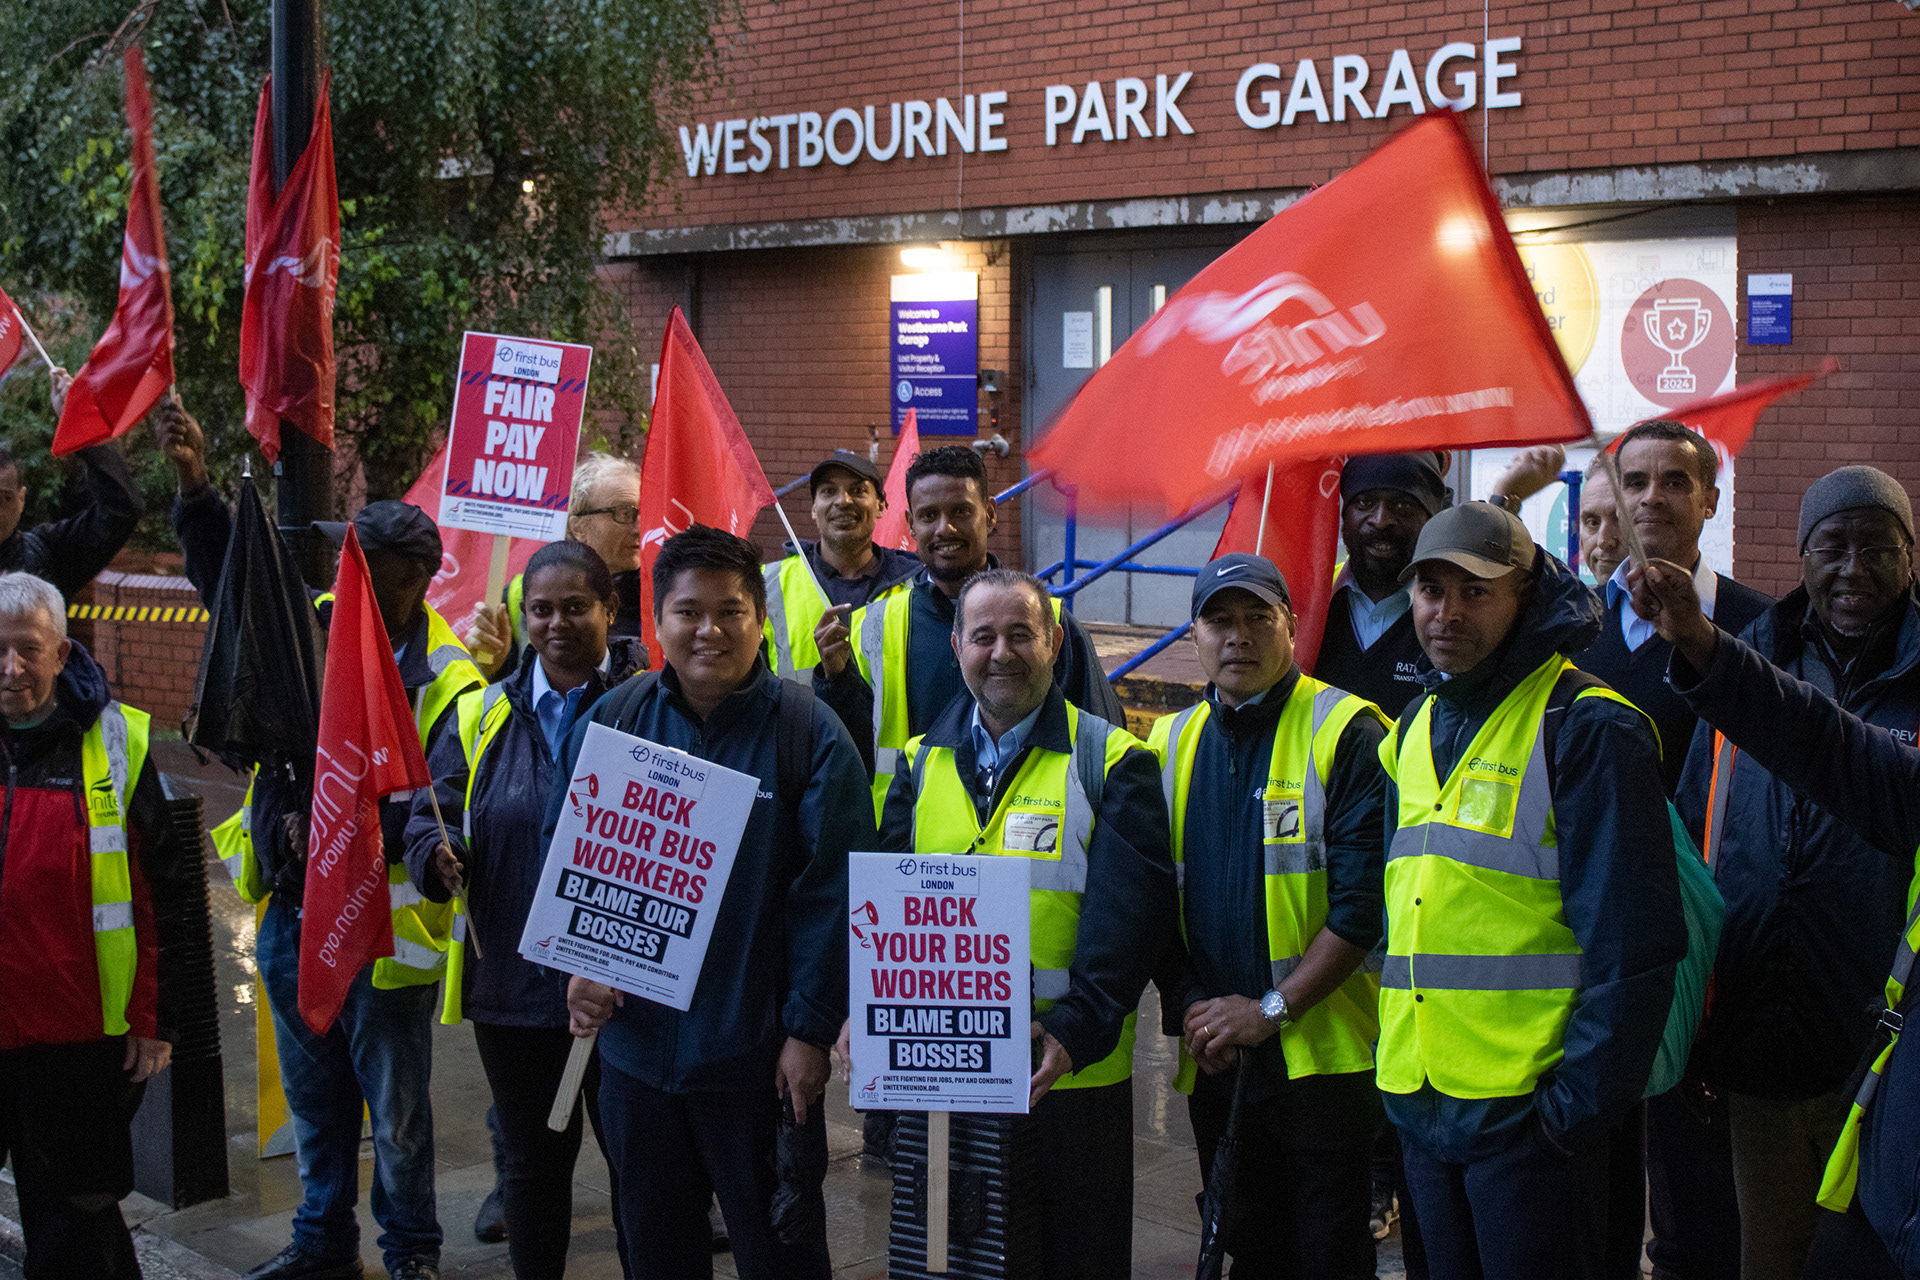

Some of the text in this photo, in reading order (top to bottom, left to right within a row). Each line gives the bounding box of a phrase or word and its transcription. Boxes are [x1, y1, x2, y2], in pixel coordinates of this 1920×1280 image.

[679, 36, 1522, 178] WESTBOURNE PARK GARAGE
[898, 321, 968, 333] Westbourne Park
[897, 334, 929, 348] Garage
[515, 352, 559, 369] first bus
[910, 353, 934, 365] Property
[514, 366, 540, 378] LONDON
[916, 364, 945, 374] Reception
[914, 386, 943, 397] Access
[1663, 379, 1690, 389] 2024
[483, 380, 555, 422] FAIR
[484, 420, 546, 460] PAY
[471, 458, 548, 501] NOW
[1393, 674, 1415, 682] TRANSIT
[1890, 728, 1917, 742] DEV
[651, 751, 706, 783] first bus
[1480, 760, 1519, 776] first bus
[647, 769, 681, 789] LONDON
[1286, 780, 1301, 789] bus
[757, 788, 773, 800] bus
[1023, 796, 1061, 807] first bus
[621, 780, 698, 828] BACK
[585, 804, 716, 871] YOUR BUS
[572, 837, 708, 904] WORKERS
[920, 861, 977, 877] first bus
[920, 879, 955, 891] LONDON
[563, 873, 690, 934] BLAME OUR
[904, 896, 978, 928] BACK
[575, 911, 661, 958] BOSSES
[555, 945, 610, 967] UNITETHEUNION.ORG
[871, 932, 1011, 965] YOUR BUS
[557, 936, 680, 981] UNITE FIGHTING FOR JOBS, PAY AND CONDITIONS
[870, 968, 1012, 1002] WORKERS
[874, 1008, 1005, 1035] BLAME OUR
[896, 1042, 983, 1069] BOSSES
[858, 1091, 880, 1100] unite
[883, 1084, 940, 1092] UNITETHEUNION.ORG
